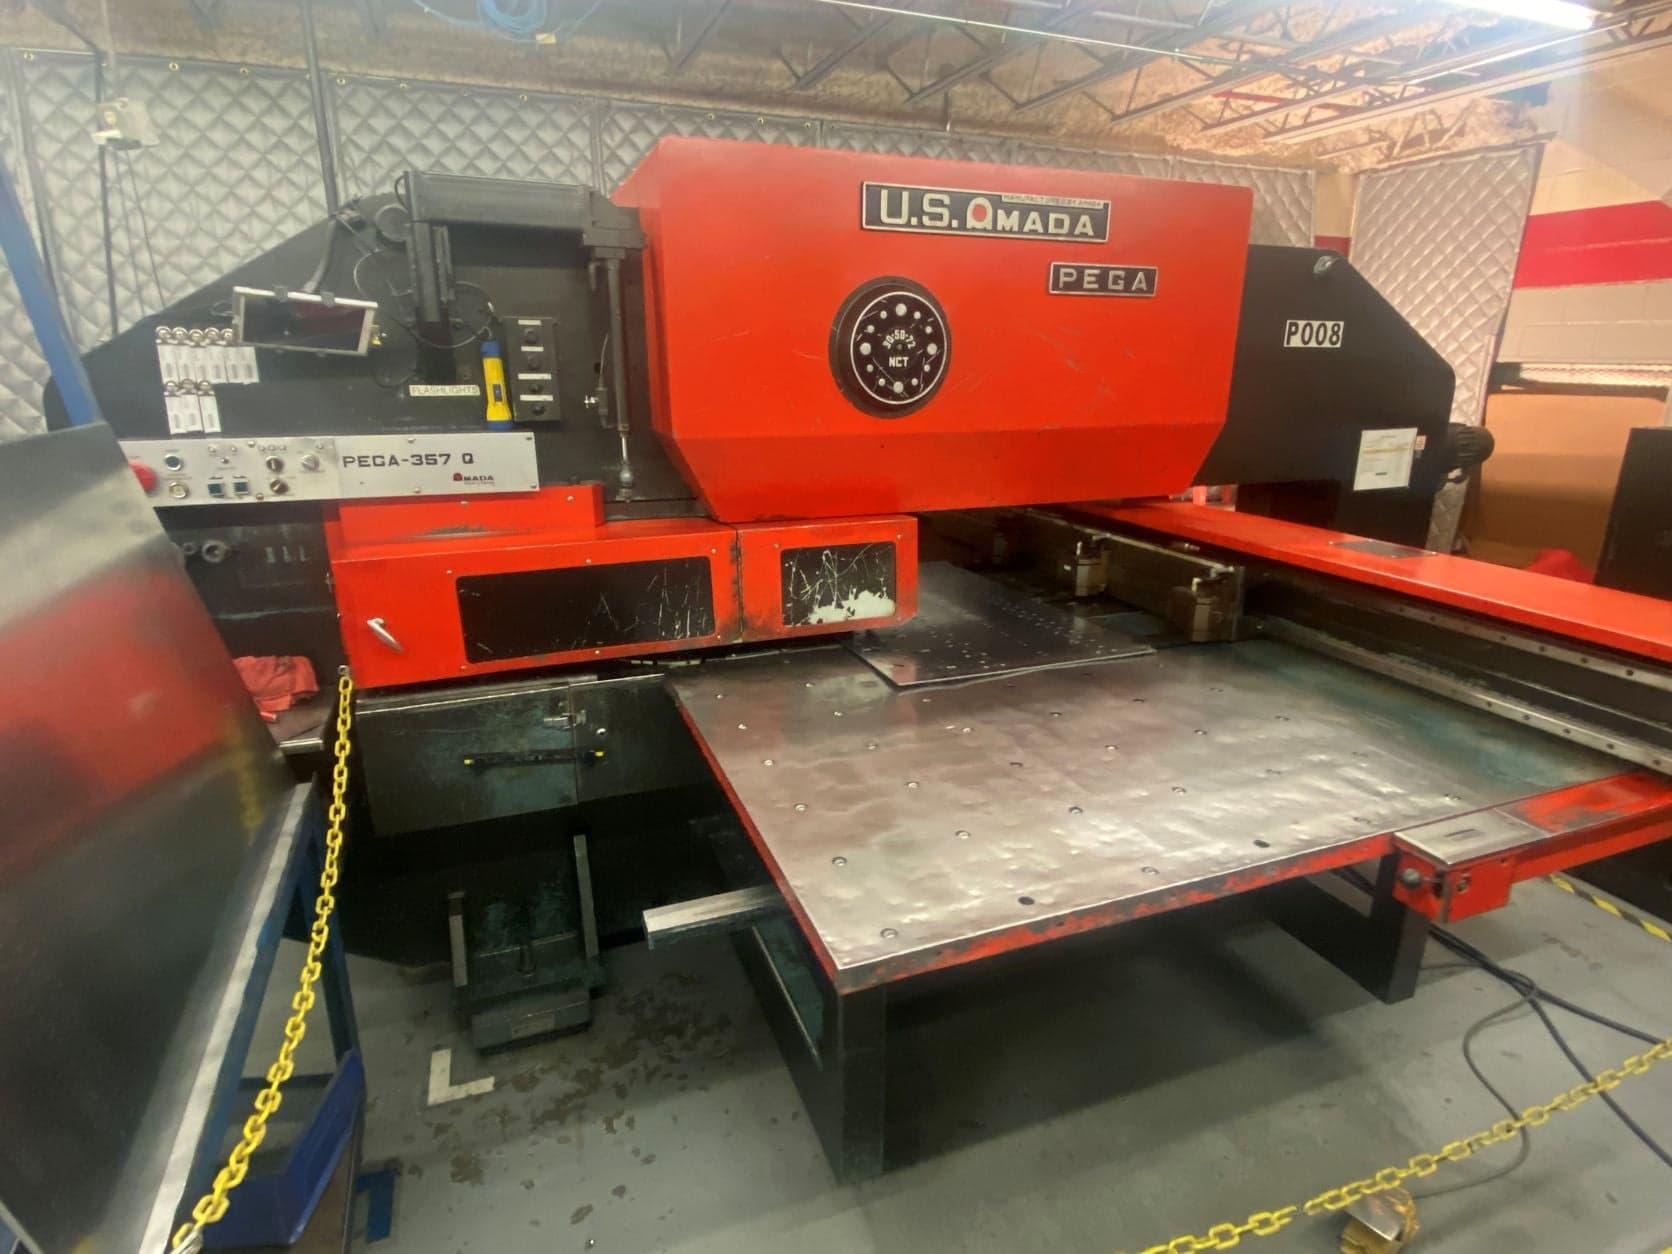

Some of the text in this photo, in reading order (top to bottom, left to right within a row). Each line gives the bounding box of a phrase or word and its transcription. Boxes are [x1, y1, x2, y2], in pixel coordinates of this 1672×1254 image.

[880, 189, 1094, 236] U.S. AMADA
[1059, 267, 1148, 291] PEGA
[1286, 321, 1341, 346] P008
[888, 356, 910, 367] NCT
[410, 385, 480, 395] FLASHLIGHTS
[342, 453, 451, 467] PEGA-357
